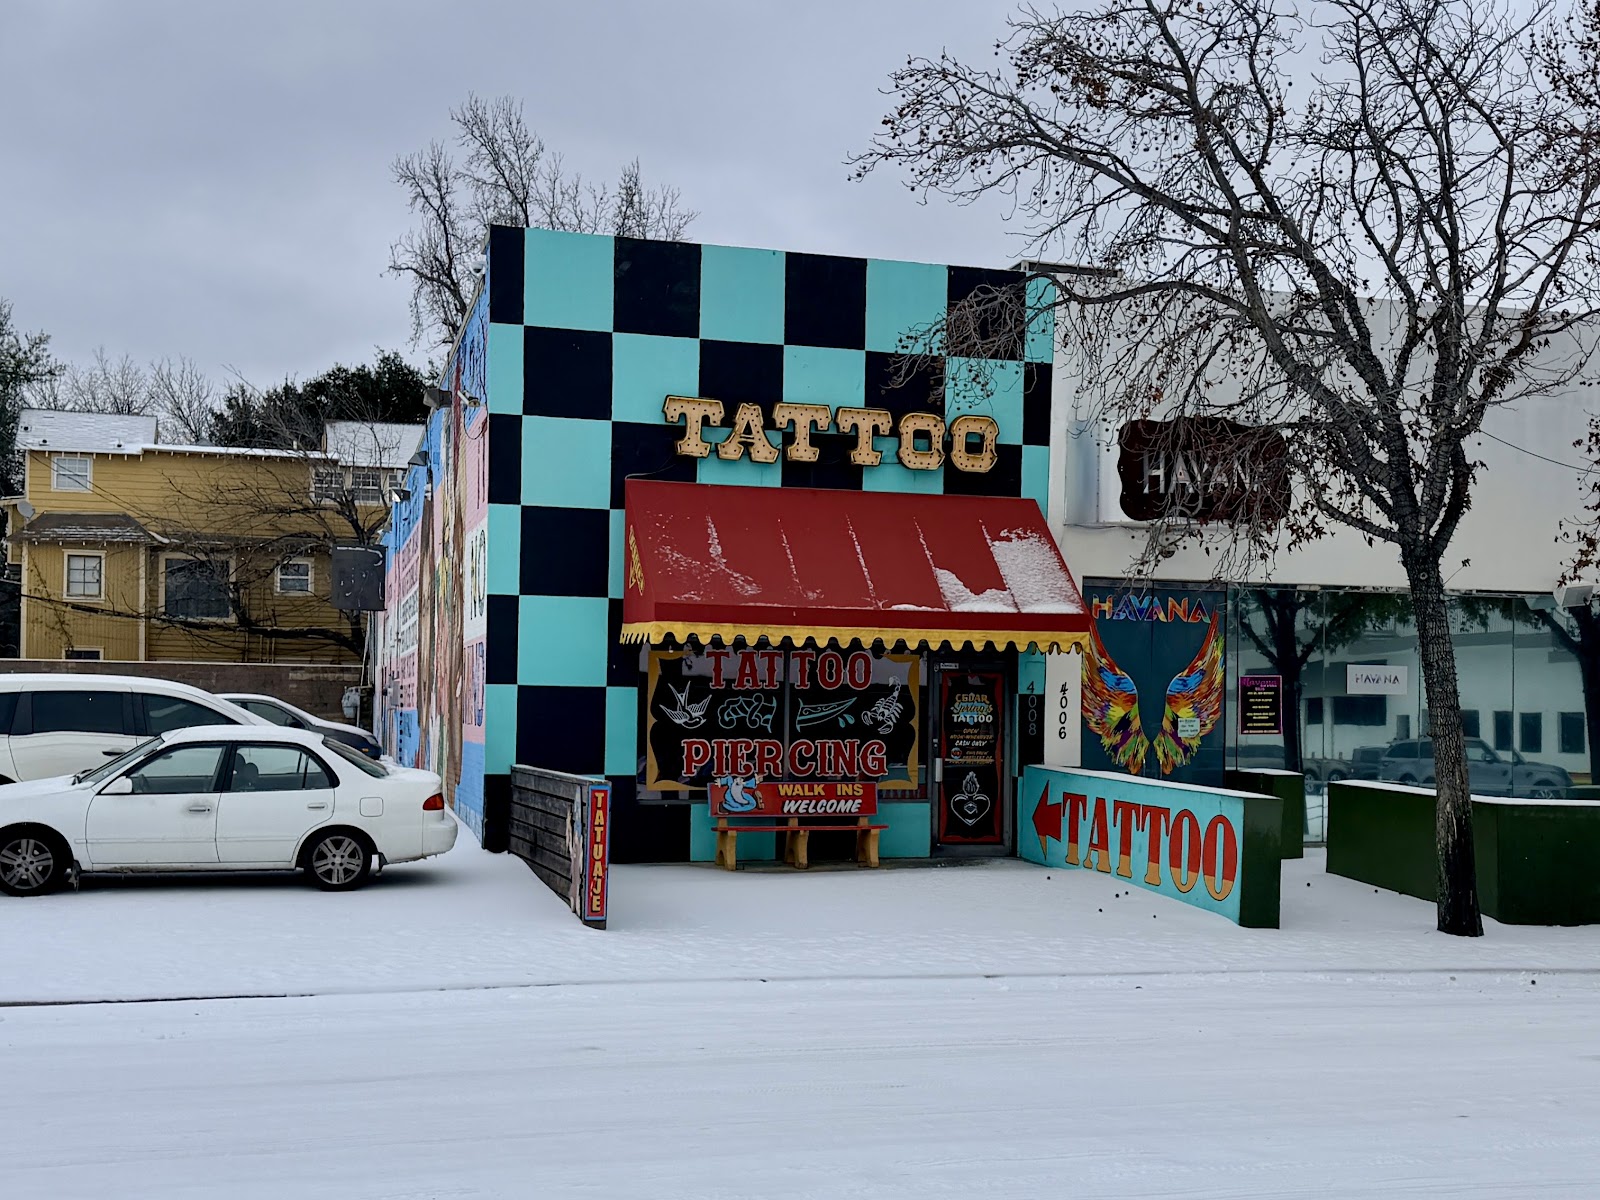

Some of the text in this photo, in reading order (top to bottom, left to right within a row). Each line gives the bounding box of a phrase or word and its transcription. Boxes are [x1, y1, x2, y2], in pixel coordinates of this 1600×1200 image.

[662, 394, 999, 473] TATTOO
[470, 529, 486, 621] NO
[1092, 593, 1211, 623] HAVANA
[705, 651, 872, 690] TATTOO
[1355, 673, 1400, 684] HAVANA
[955, 693, 990, 704] CEDAR
[1026, 681, 1037, 735] 4008
[1059, 681, 1068, 739] 4006
[951, 714, 993, 723] TATTOO
[682, 739, 888, 777] PIERCING
[778, 783, 864, 797] WALK INS
[782, 799, 863, 814] WELCOME
[591, 792, 605, 913] TATUAJE
[1062, 791, 1237, 901] TATTOO
